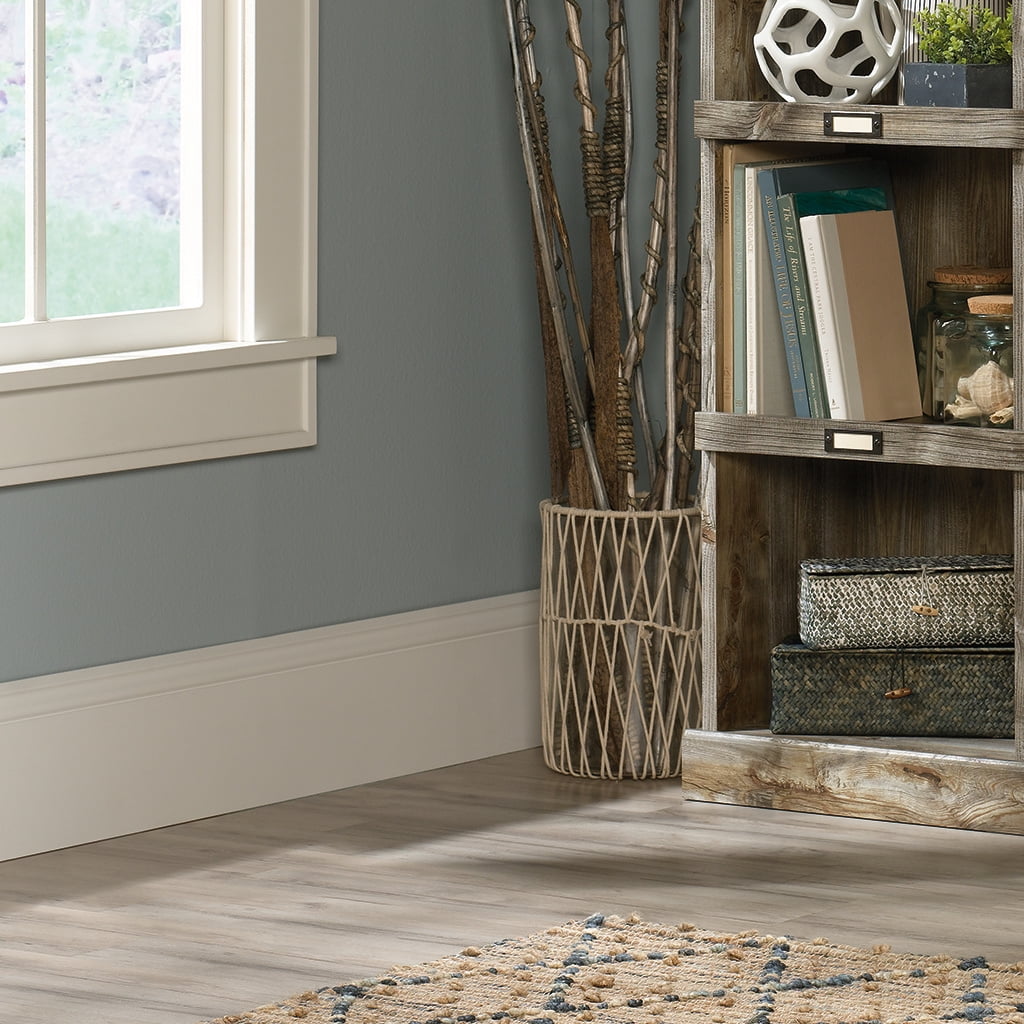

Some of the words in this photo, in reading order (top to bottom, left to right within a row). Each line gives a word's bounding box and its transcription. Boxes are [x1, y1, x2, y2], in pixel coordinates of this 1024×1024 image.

[783, 207, 791, 222] The
[785, 226, 794, 242] Life
[786, 246, 796, 254] of
[790, 258, 799, 282] Rivers
[794, 286, 804, 302] and
[798, 306, 807, 335] Streams
